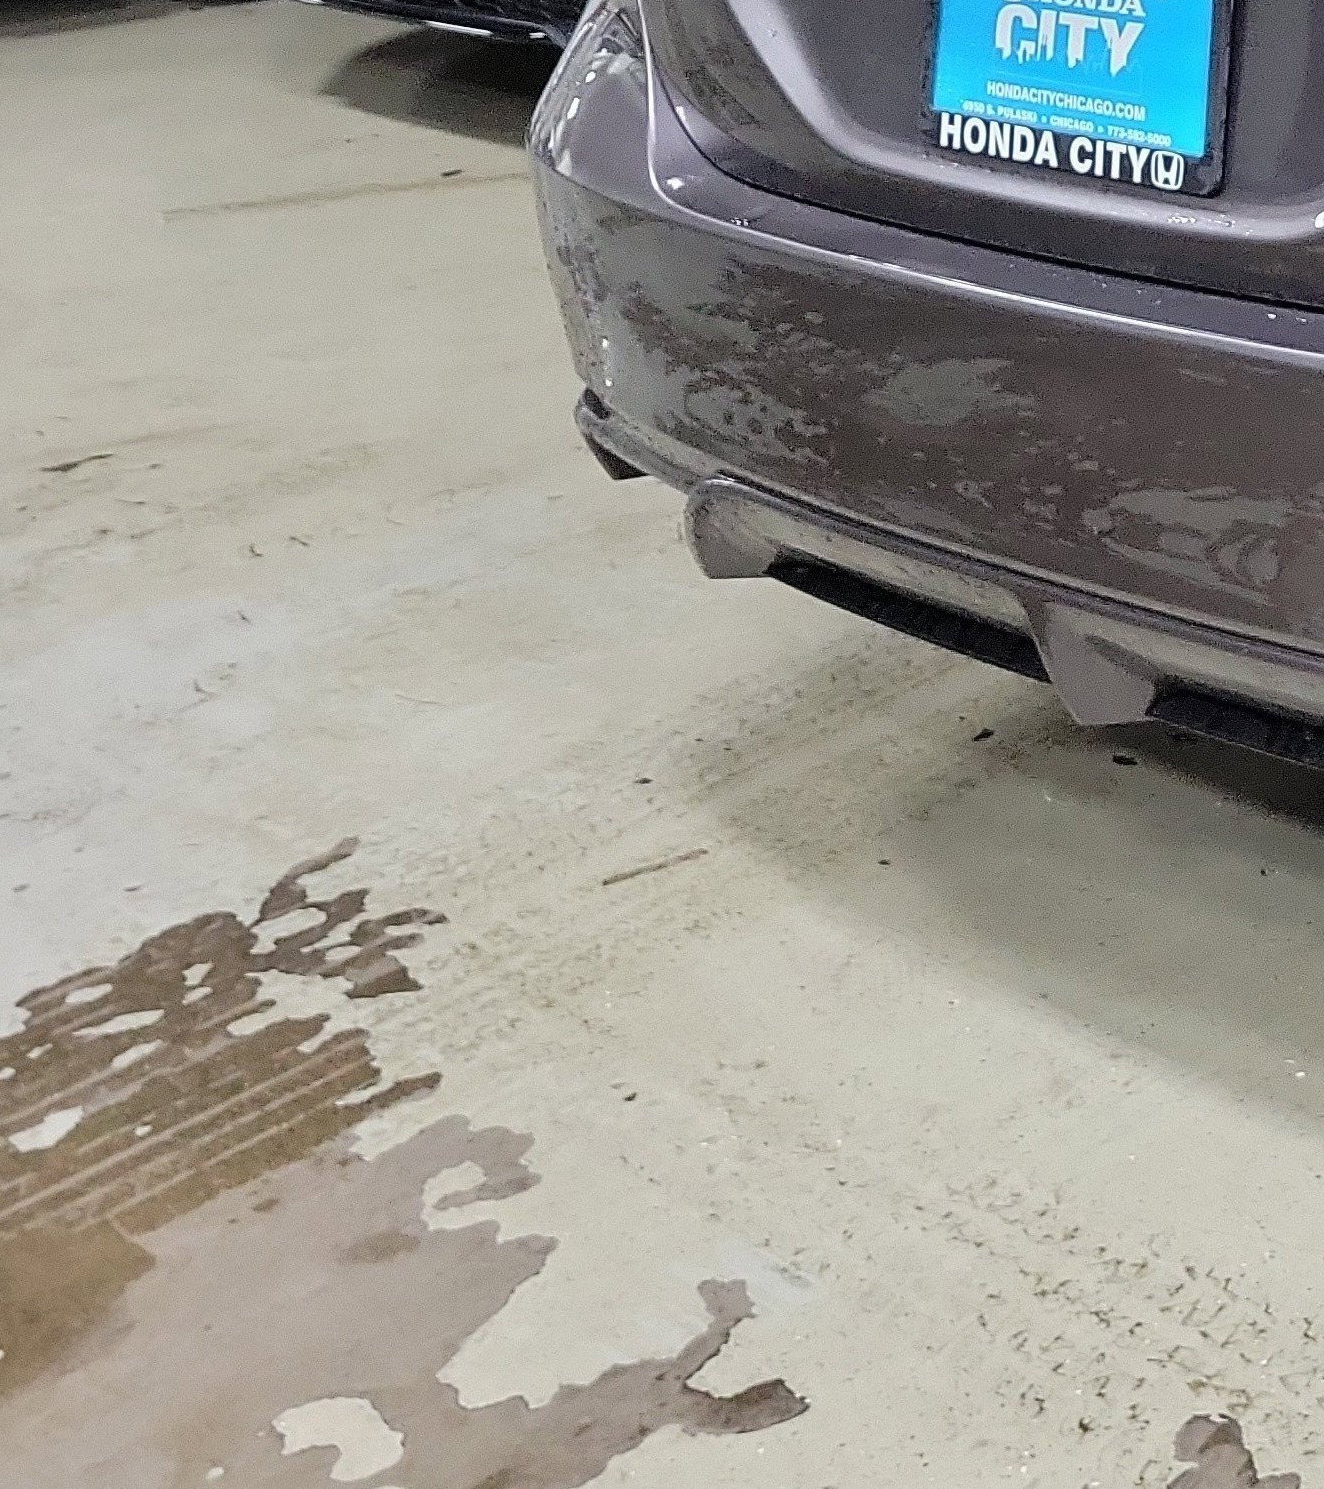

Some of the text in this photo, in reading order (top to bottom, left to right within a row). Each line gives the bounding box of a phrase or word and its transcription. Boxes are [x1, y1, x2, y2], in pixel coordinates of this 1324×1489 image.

[995, 3, 1145, 77] CITY
[986, 80, 1146, 121] HONDACITYCHICAGO.COM
[997, 105, 1037, 123] PULASKI
[1049, 114, 1094, 133] CHICAGO
[939, 111, 1151, 184] HONDA CITY
